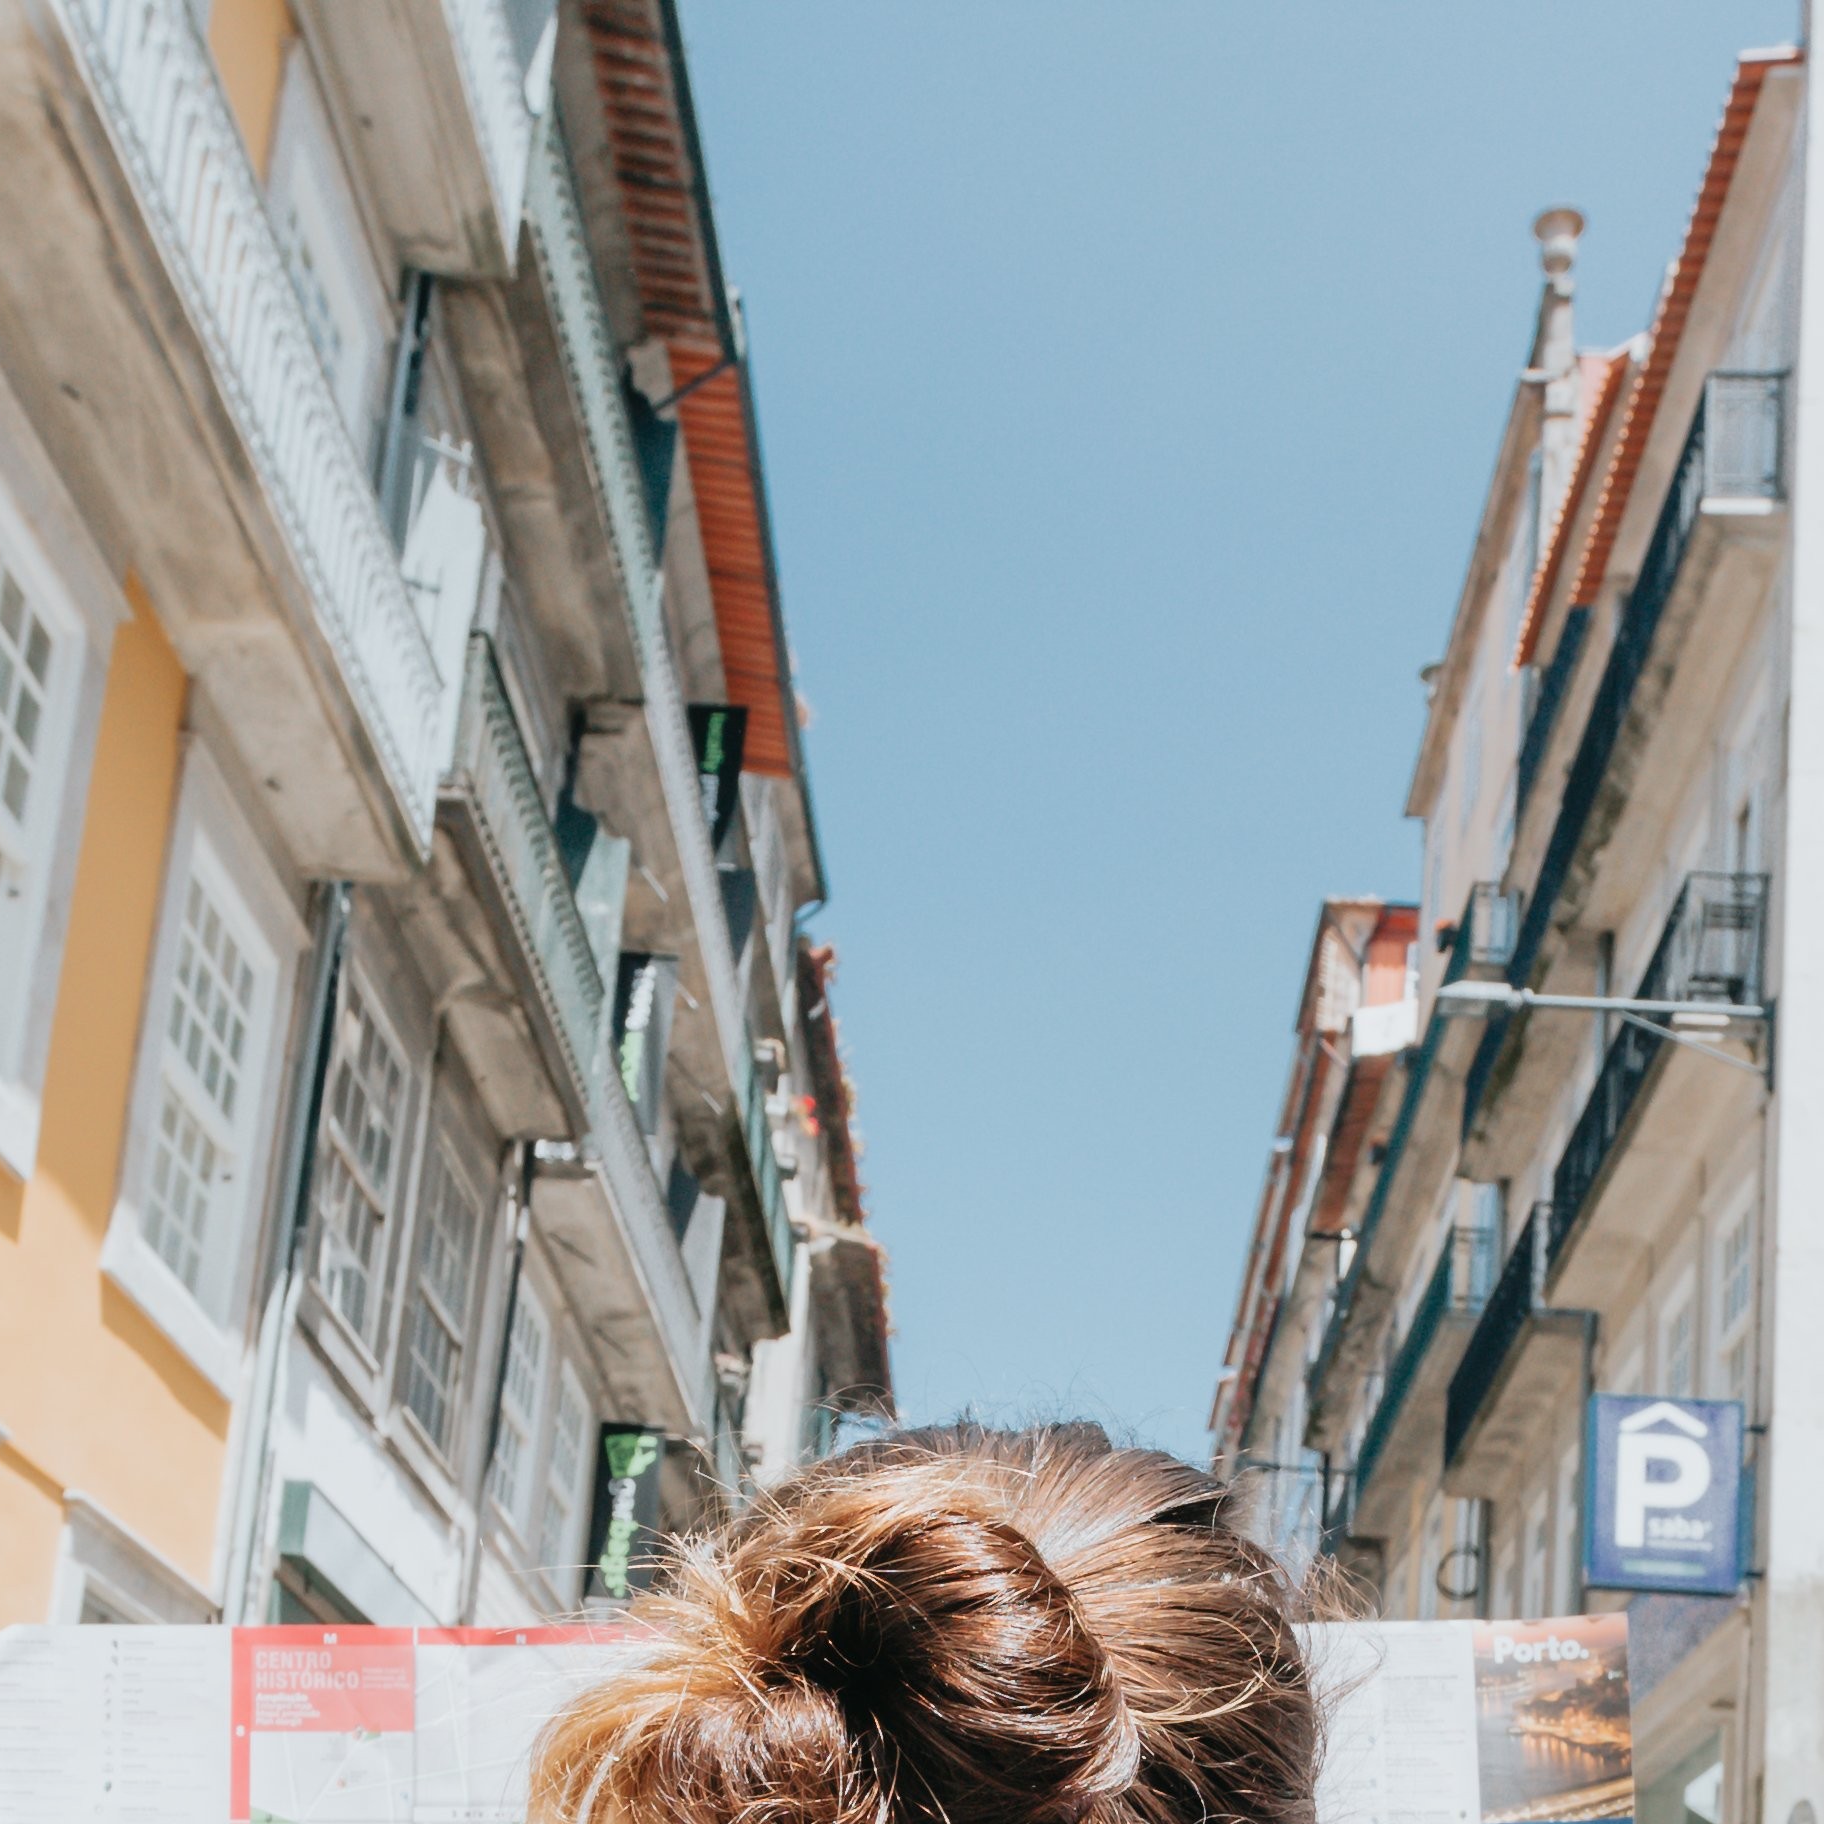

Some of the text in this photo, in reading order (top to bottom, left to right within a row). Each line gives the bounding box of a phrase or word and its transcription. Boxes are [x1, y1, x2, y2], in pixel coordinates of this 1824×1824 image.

[1616, 1432, 1710, 1547] P
[323, 1633, 337, 1644] M
[515, 1633, 527, 1645] N
[255, 1651, 332, 1669] CENTRO
[1493, 1635, 1589, 1665] Porto.
[255, 1667, 360, 1690] HISTÓRICO
